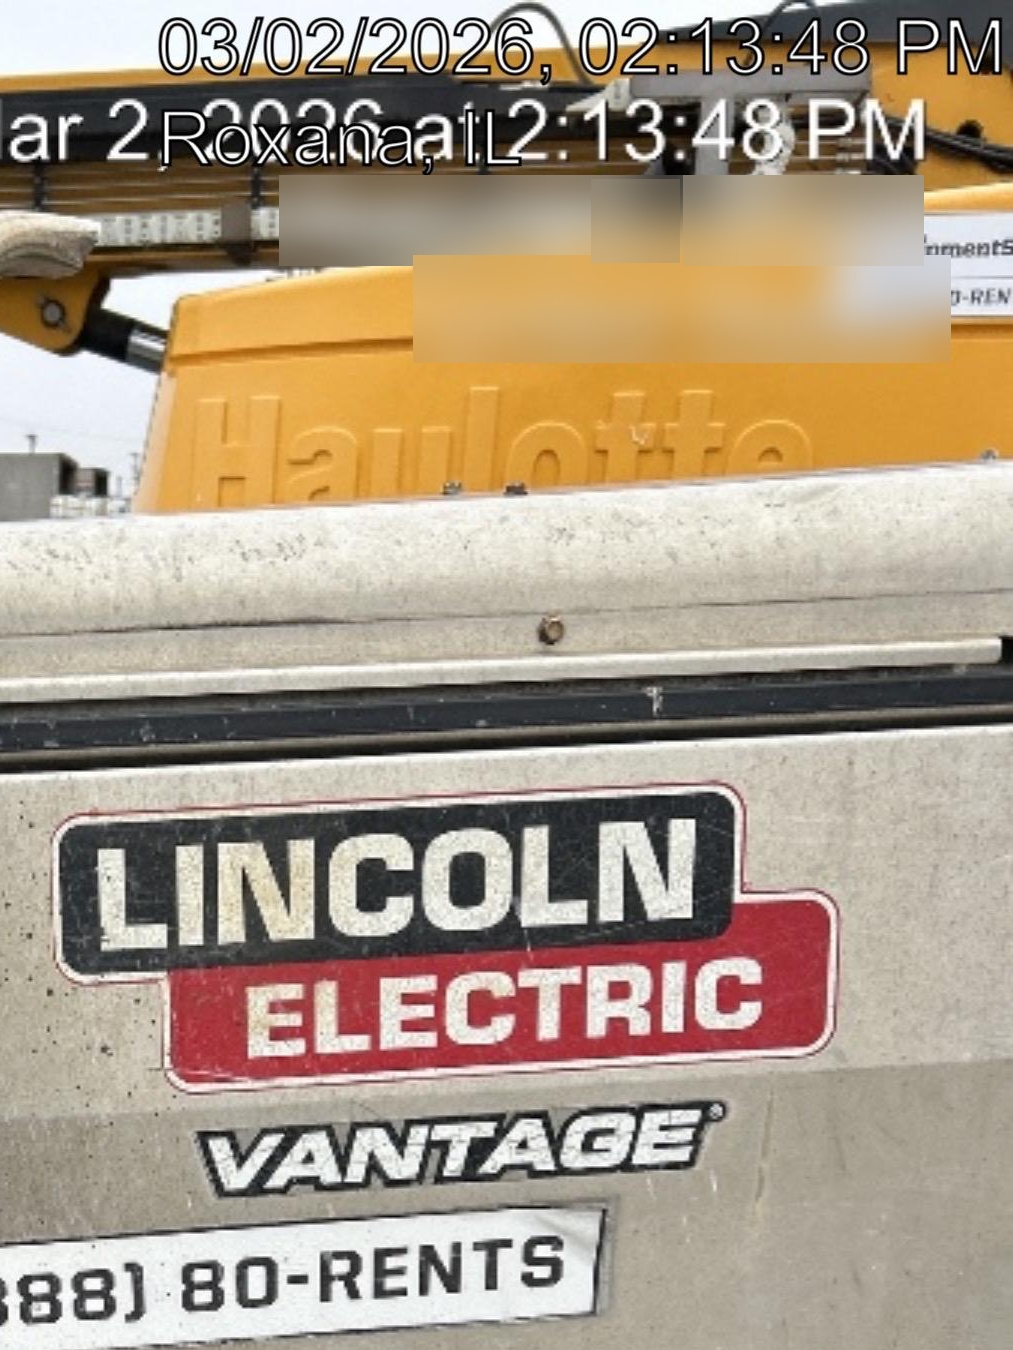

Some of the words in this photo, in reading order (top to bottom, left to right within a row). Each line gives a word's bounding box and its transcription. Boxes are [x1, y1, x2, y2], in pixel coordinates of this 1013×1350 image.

[97, 817, 697, 953] LINCOLN
[245, 956, 763, 1059] ELECTRIC
[200, 1106, 710, 1196] VANTAGE
[182, 1235, 566, 1312] 80-RENTS
